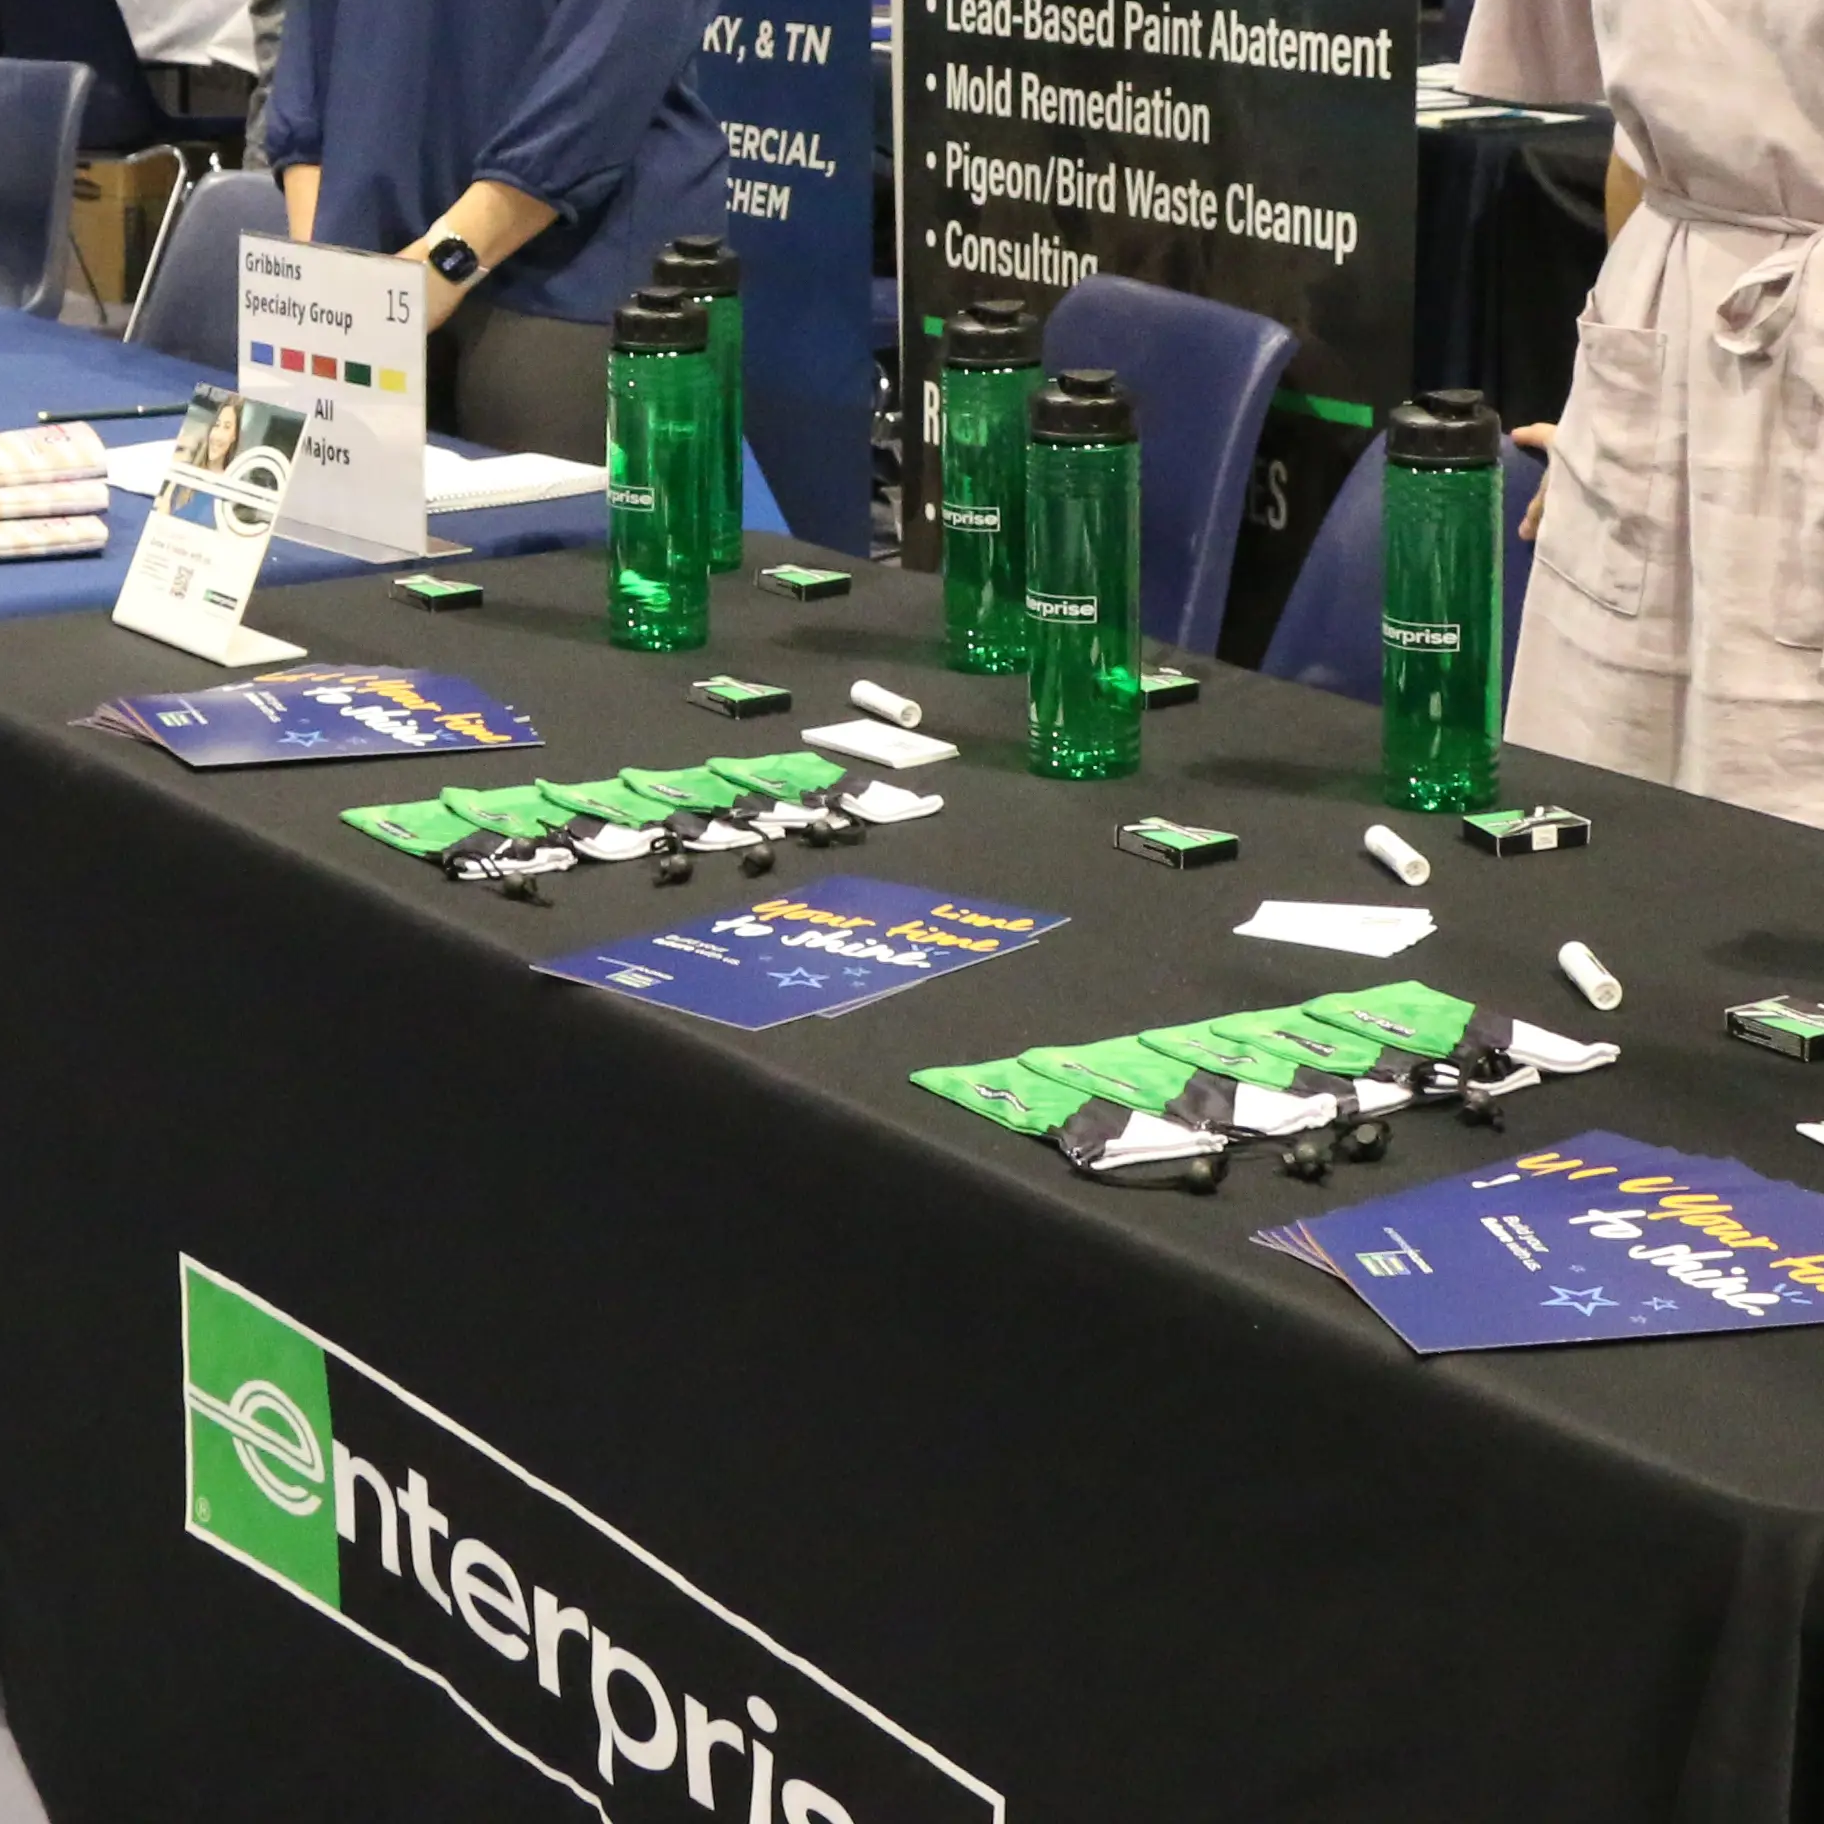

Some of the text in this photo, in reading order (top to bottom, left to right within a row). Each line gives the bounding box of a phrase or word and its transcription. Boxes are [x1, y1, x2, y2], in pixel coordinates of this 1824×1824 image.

[755, 22, 776, 60] &
[785, 23, 832, 65] TN
[1125, 1, 1202, 60] Paint
[1209, 9, 1392, 81] Abatement
[946, 64, 1210, 144] Mold Remediation
[720, 122, 837, 177] ERCIAL,
[946, 139, 1358, 265] Pigeon/Bird Waste Cleanup
[245, 253, 302, 280] Gribbins
[245, 290, 353, 335] Specialty Group
[385, 289, 410, 324] 15
[315, 398, 334, 421] All
[1569, 1209, 1647, 1240] to
[1647, 1194, 1778, 1252] Your
